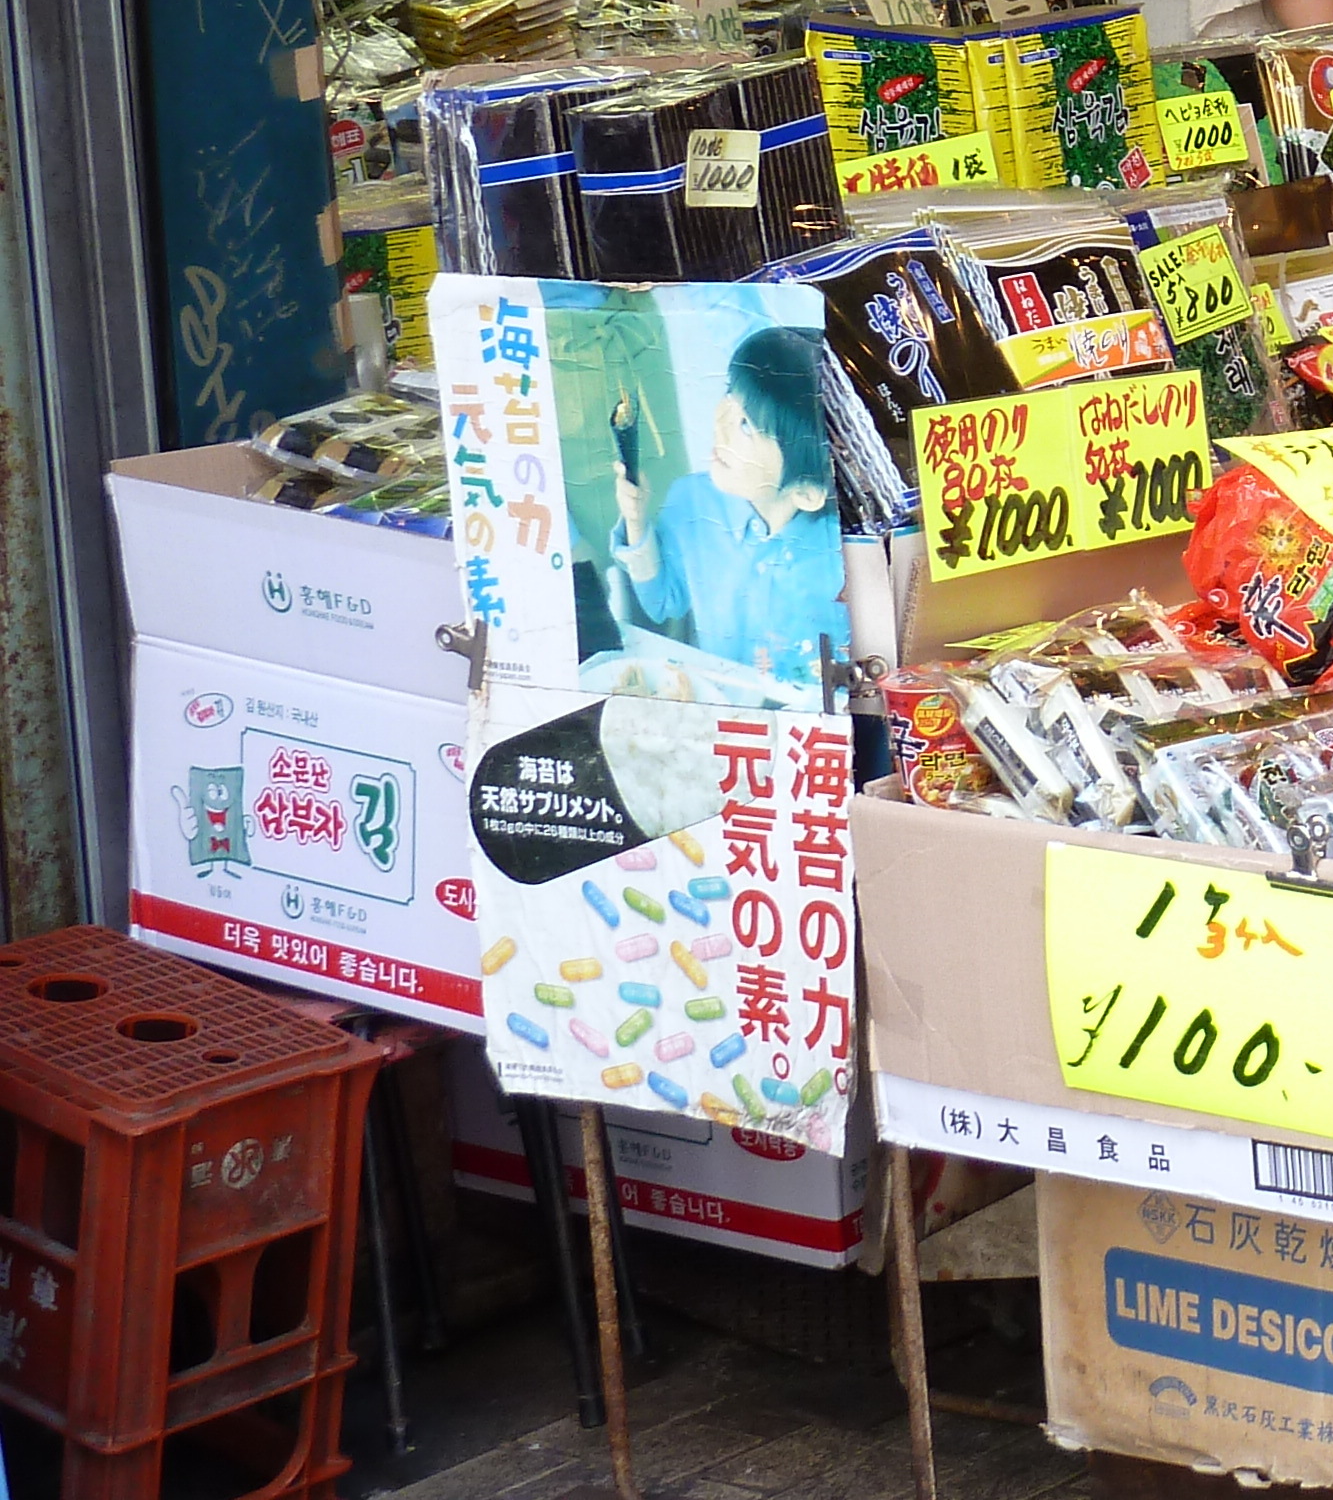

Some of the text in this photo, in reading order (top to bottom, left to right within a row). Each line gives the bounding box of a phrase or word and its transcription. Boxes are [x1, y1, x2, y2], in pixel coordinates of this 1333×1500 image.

[1053, 85, 1129, 148] 삼육김
[1149, 244, 1185, 288] SALE!
[1176, 280, 1233, 323] ¥800
[1031, 319, 1129, 368] うまい 焼のり
[480, 297, 564, 571] 海苔の力。
[1079, 380, 1197, 438] はねだしのり
[924, 404, 1028, 474] 徳用のり
[449, 384, 520, 641] 元気の素。
[1286, 536, 1330, 597] 라면
[1240, 572, 1309, 647] 辛
[292, 707, 319, 727] 국내산
[271, 749, 331, 790] 소문난
[519, 755, 574, 785] 海苔は
[921, 750, 967, 768] 라면
[256, 792, 345, 848] 삼부자
[354, 777, 400, 866] 김
[481, 785, 623, 824] 天然サプリメント。
[712, 719, 792, 1082] 元気の素。
[786, 725, 854, 1097] 海苔の力。
[224, 922, 424, 993] 더욱 맛있어 좋습니다.
[940, 1105, 1171, 1173] (株)大昌食品
[651, 1188, 731, 1225] 좋습니다.
[1116, 1278, 1201, 1333] LIME
